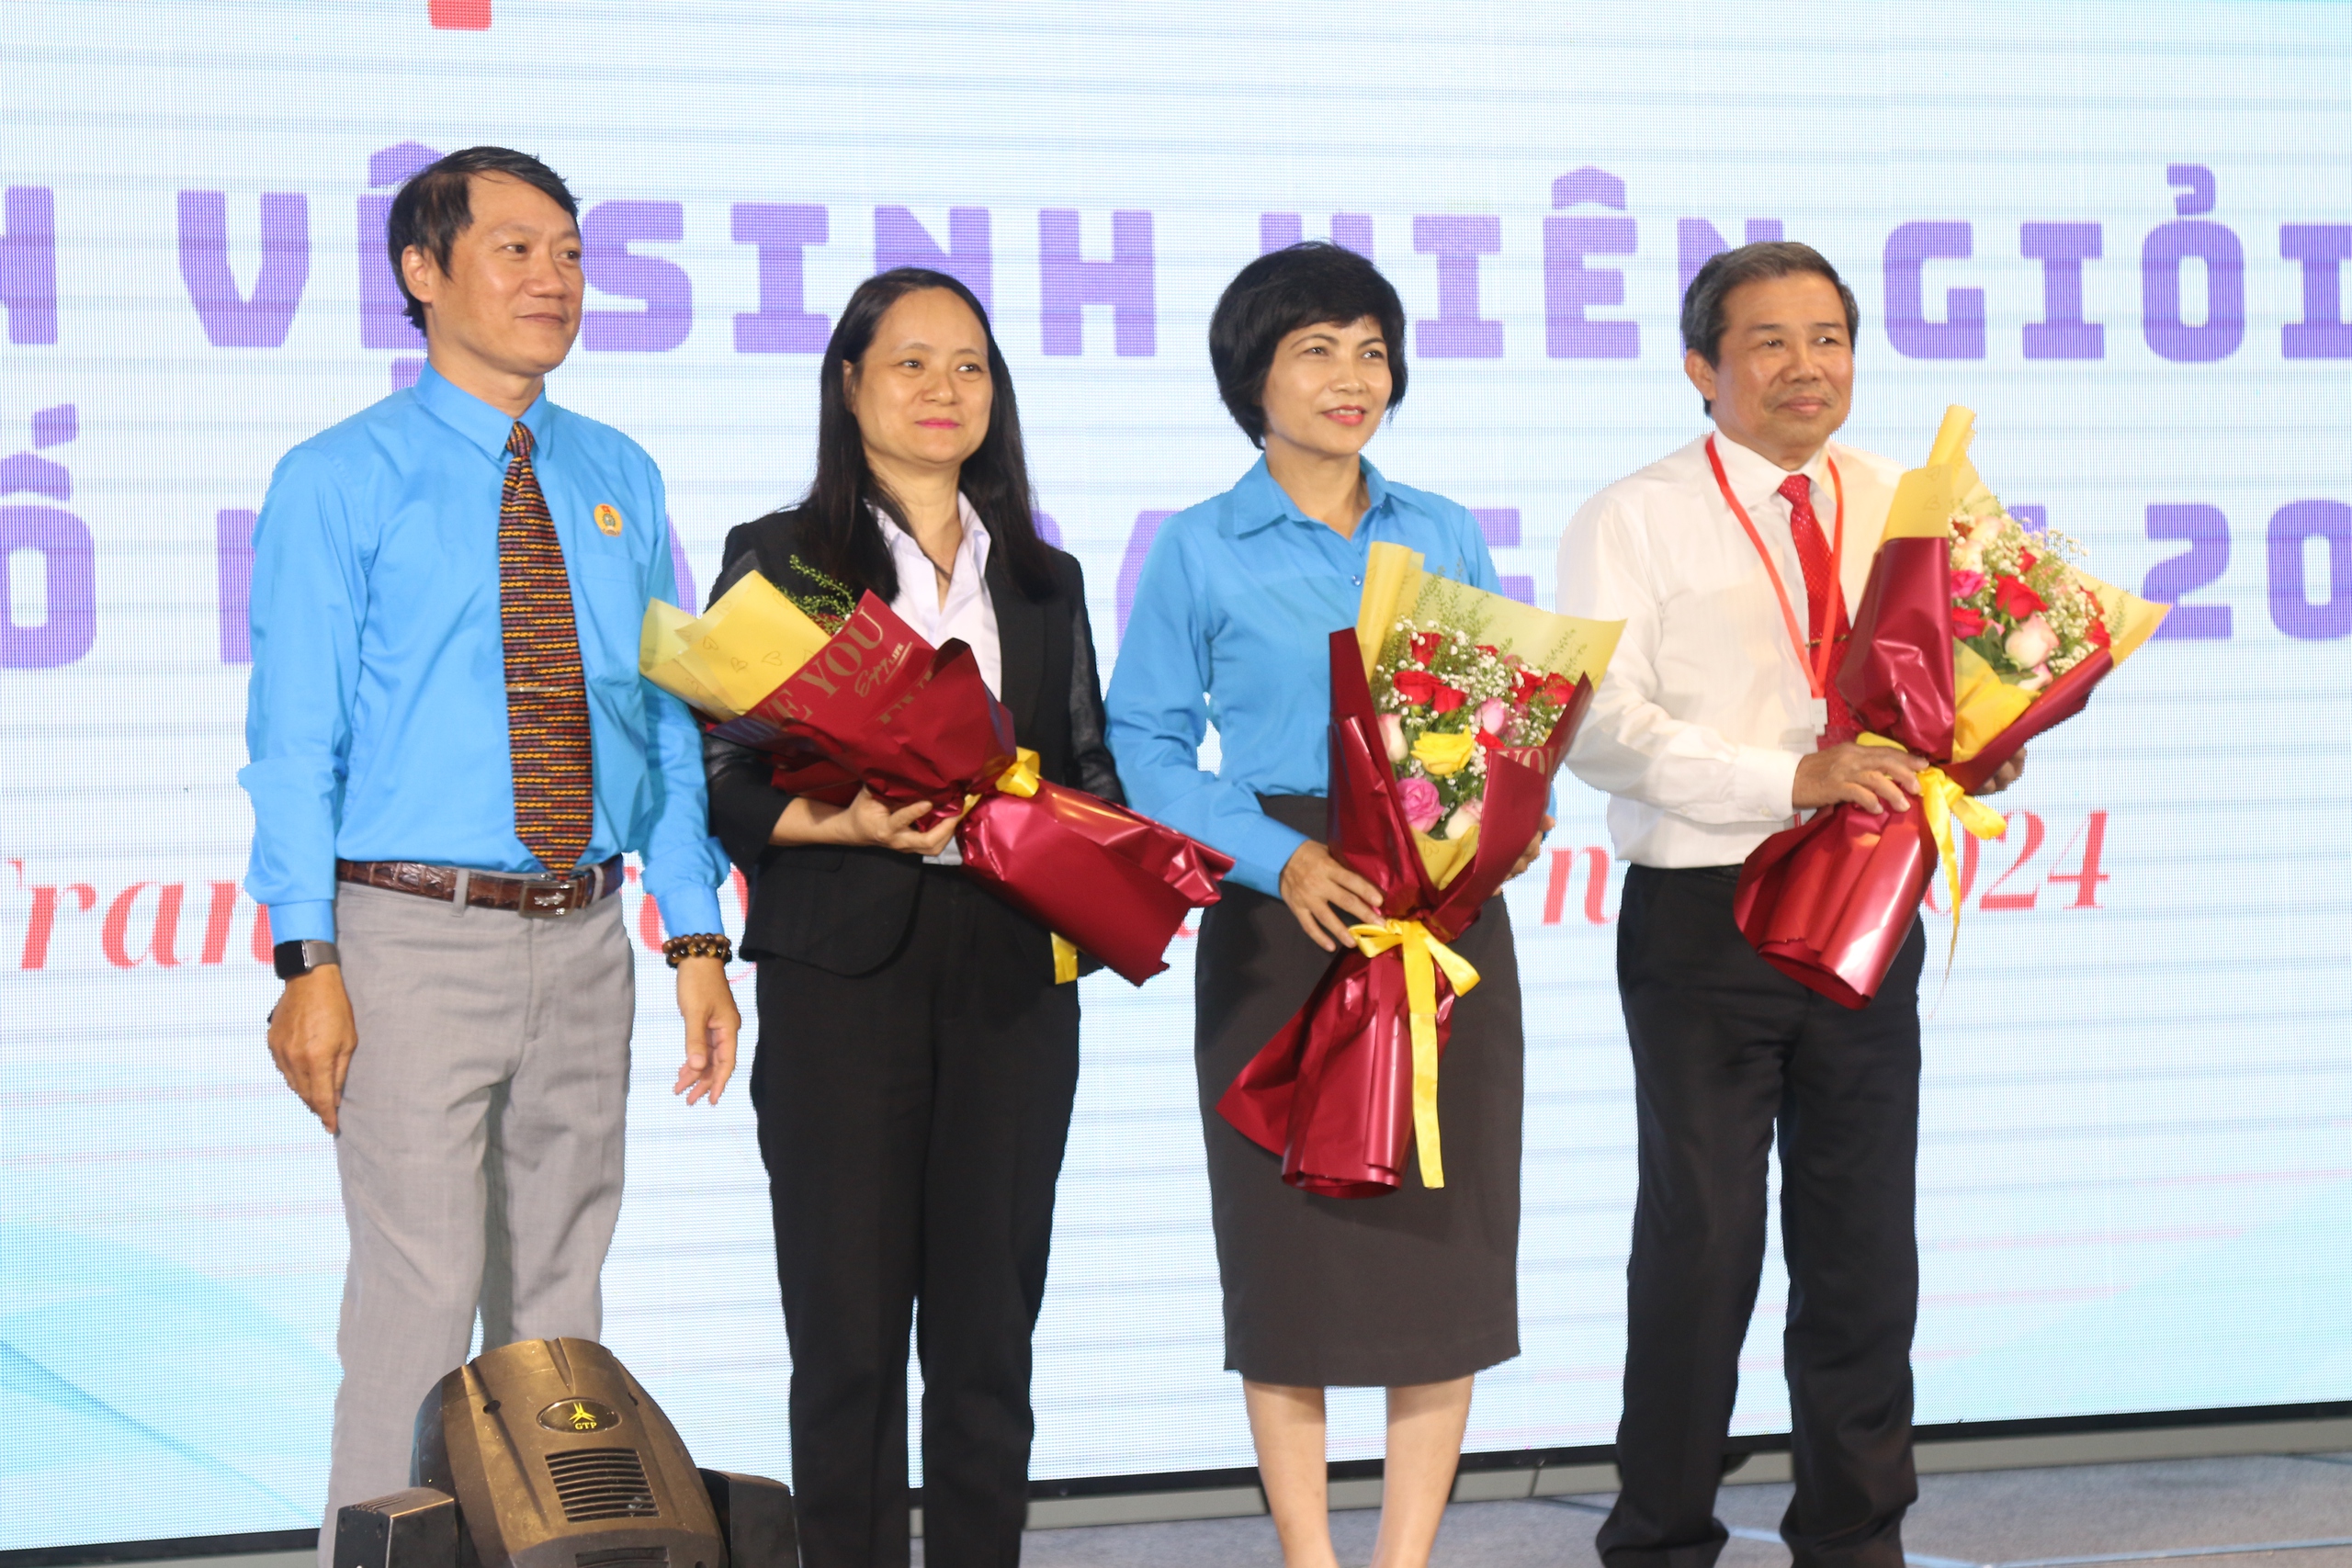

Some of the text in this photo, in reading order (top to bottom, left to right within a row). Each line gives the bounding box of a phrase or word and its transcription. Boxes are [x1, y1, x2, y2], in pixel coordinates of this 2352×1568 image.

[580, 199, 1156, 358] SINH
[1883, 163, 2352, 365] GIỎI
[796, 606, 884, 699] YOU
[574, 1421, 598, 1430] GTP
